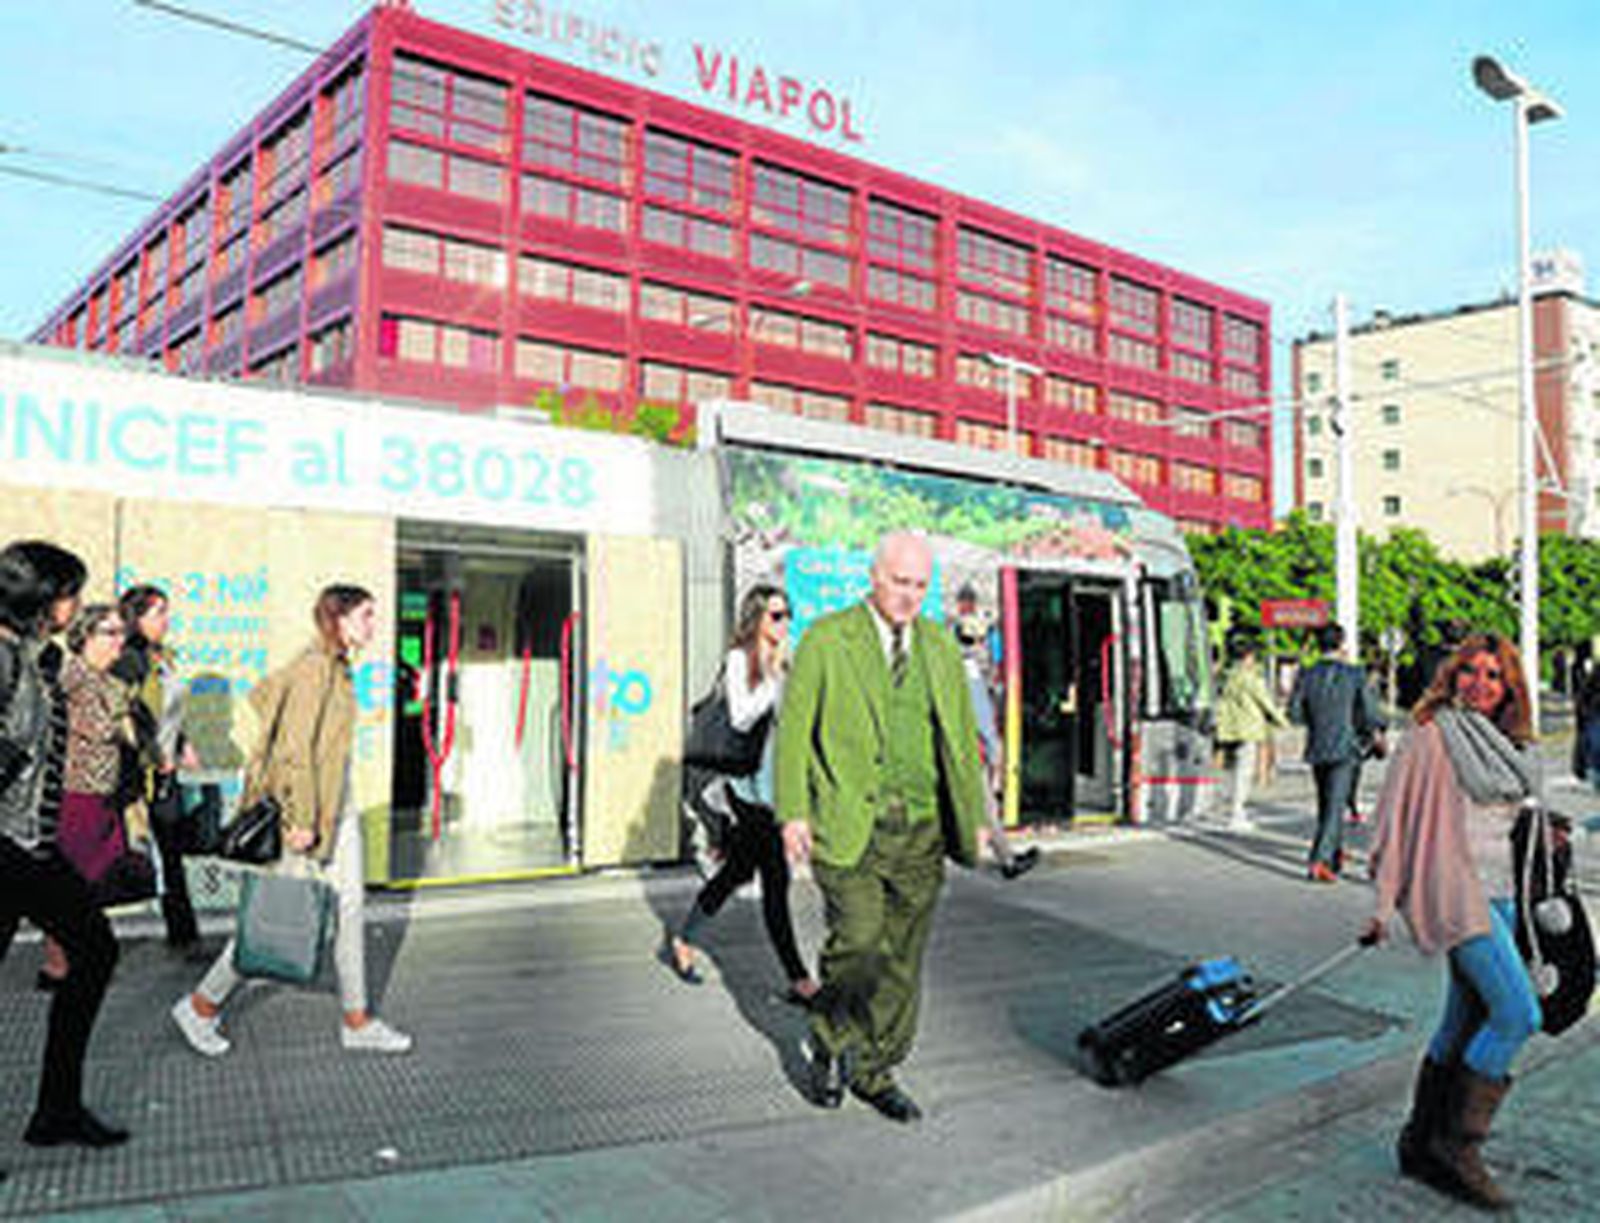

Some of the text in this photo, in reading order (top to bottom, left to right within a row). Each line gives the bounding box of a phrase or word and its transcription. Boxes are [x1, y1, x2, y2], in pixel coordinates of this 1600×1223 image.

[693, 42, 864, 141] VIAPOL
[0, 391, 597, 507] NICEF al 38028
